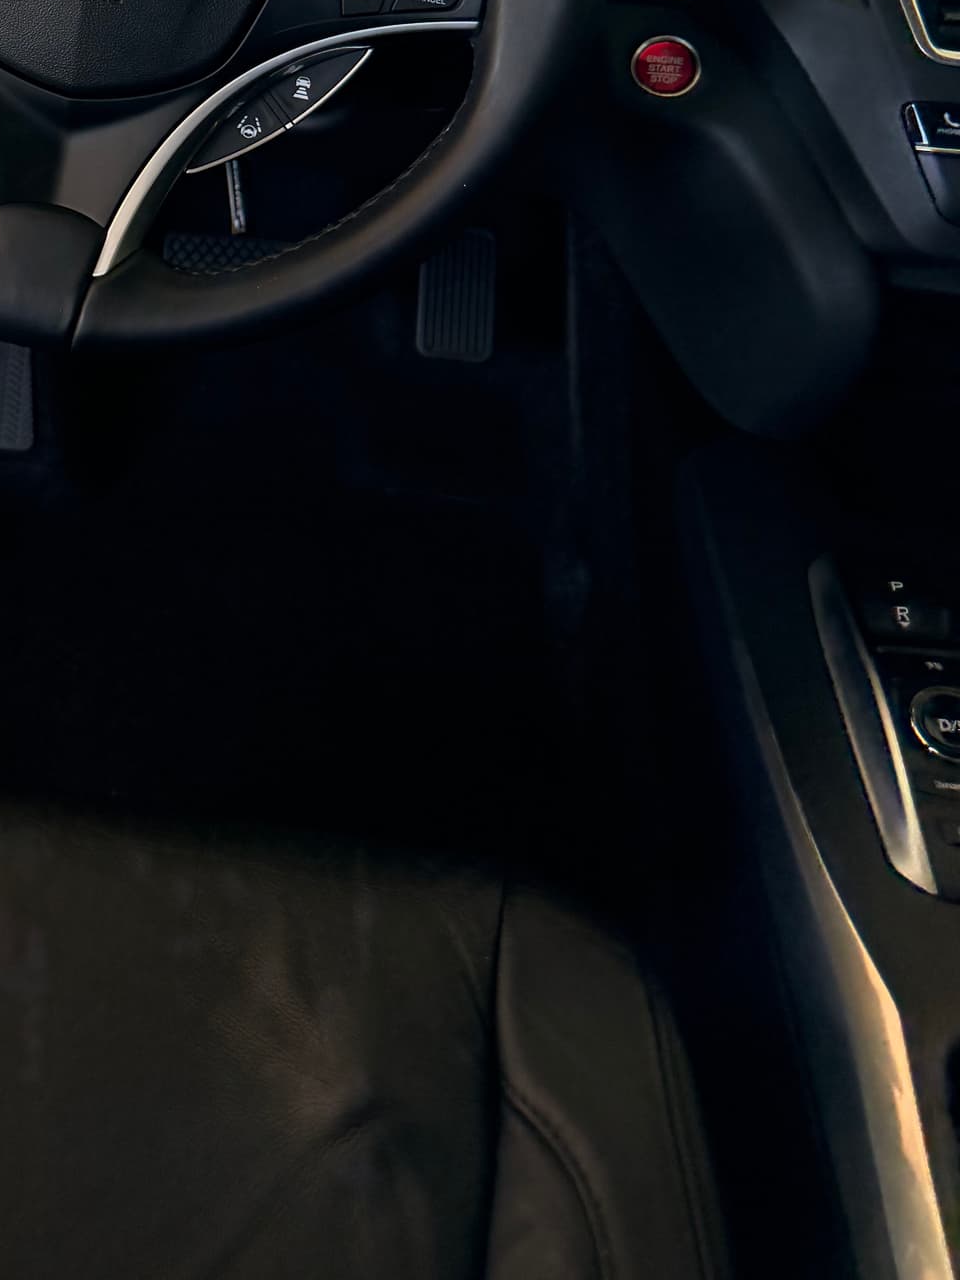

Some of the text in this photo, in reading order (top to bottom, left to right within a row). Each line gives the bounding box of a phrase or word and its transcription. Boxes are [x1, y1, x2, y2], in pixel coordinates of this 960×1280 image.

[646, 55, 684, 65] ENGINE
[648, 63, 682, 73] START
[650, 75, 678, 83] STOP
[890, 581, 903, 591] P
[896, 606, 909, 621] R
